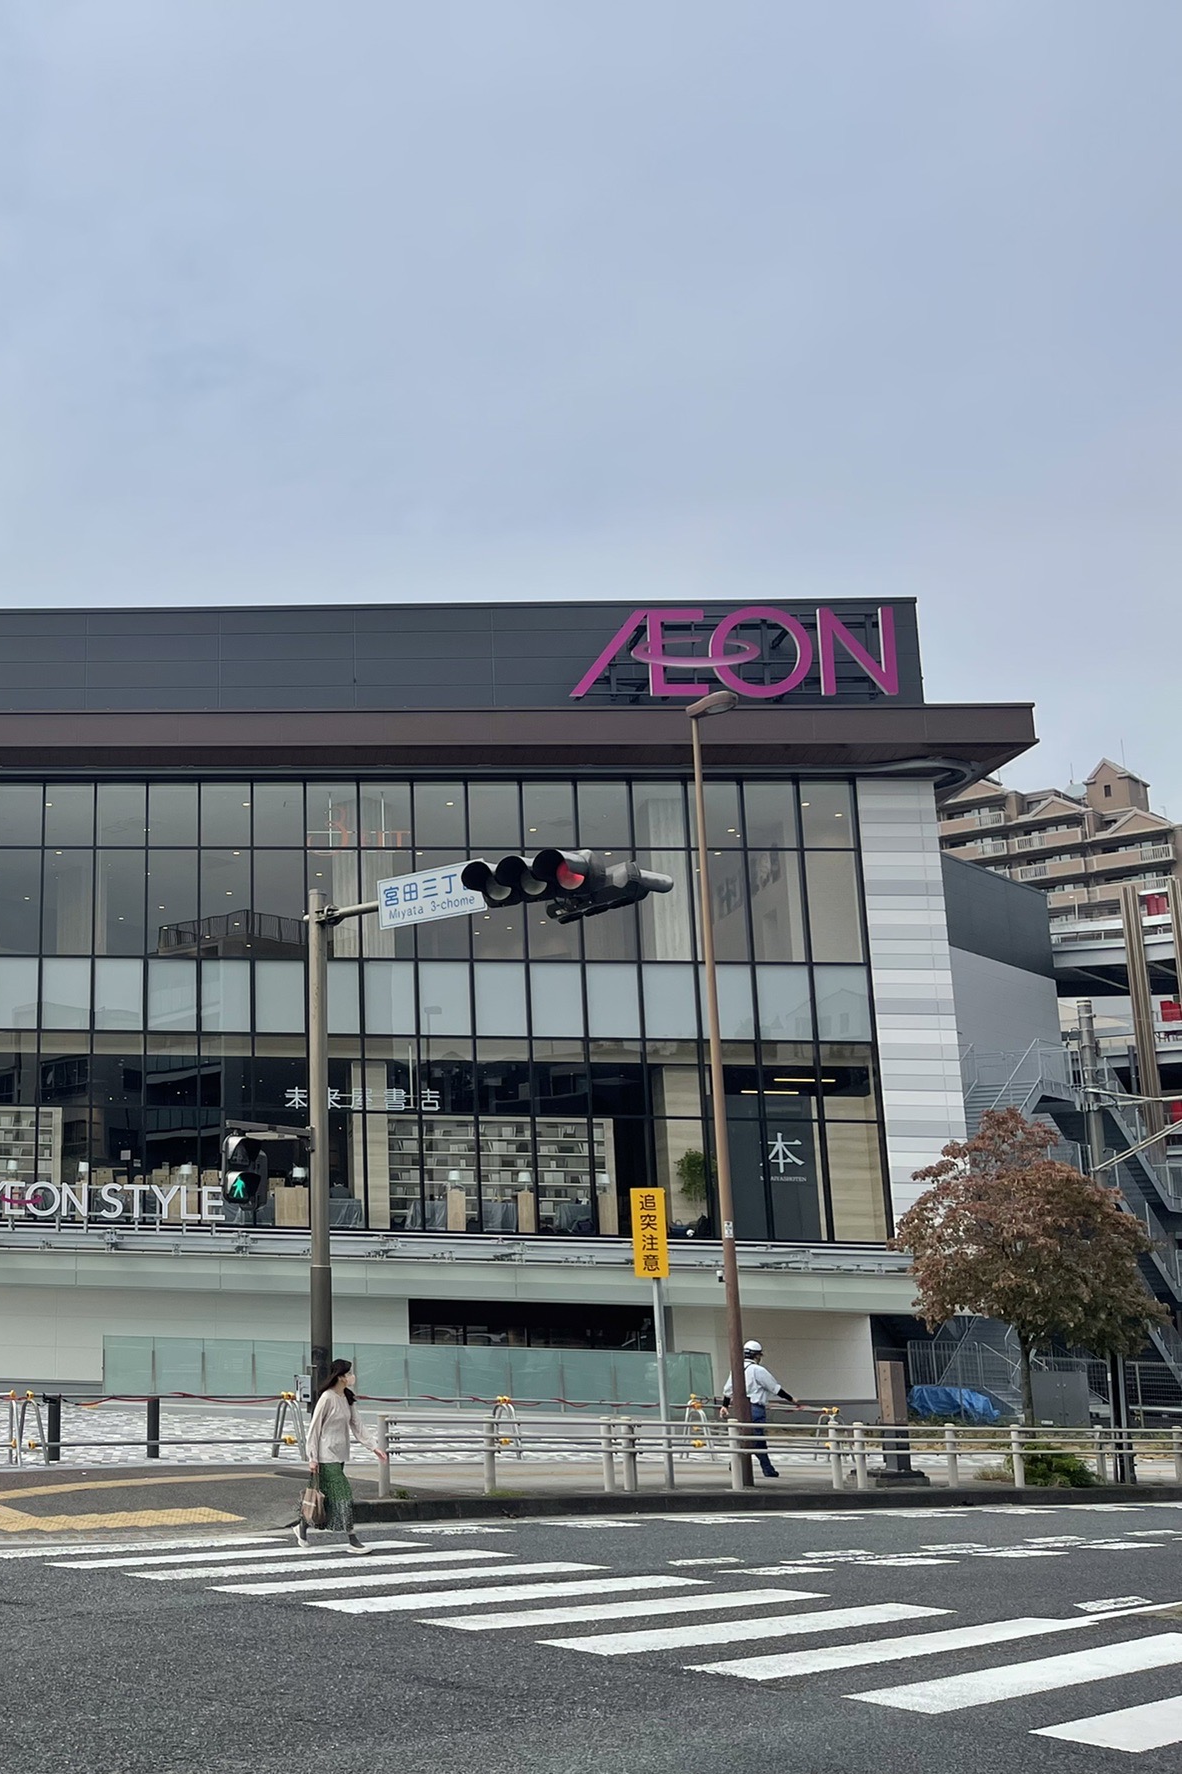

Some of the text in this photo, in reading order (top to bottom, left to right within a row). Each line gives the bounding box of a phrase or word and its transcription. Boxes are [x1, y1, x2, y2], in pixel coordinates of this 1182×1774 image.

[383, 874, 468, 907] 宮田三丁
[389, 895, 475, 920] Miyata 3-chome
[759, 1132, 806, 1173] 本
[100, 1182, 226, 1221] STYLE
[639, 1194, 660, 1272] 追突注意
